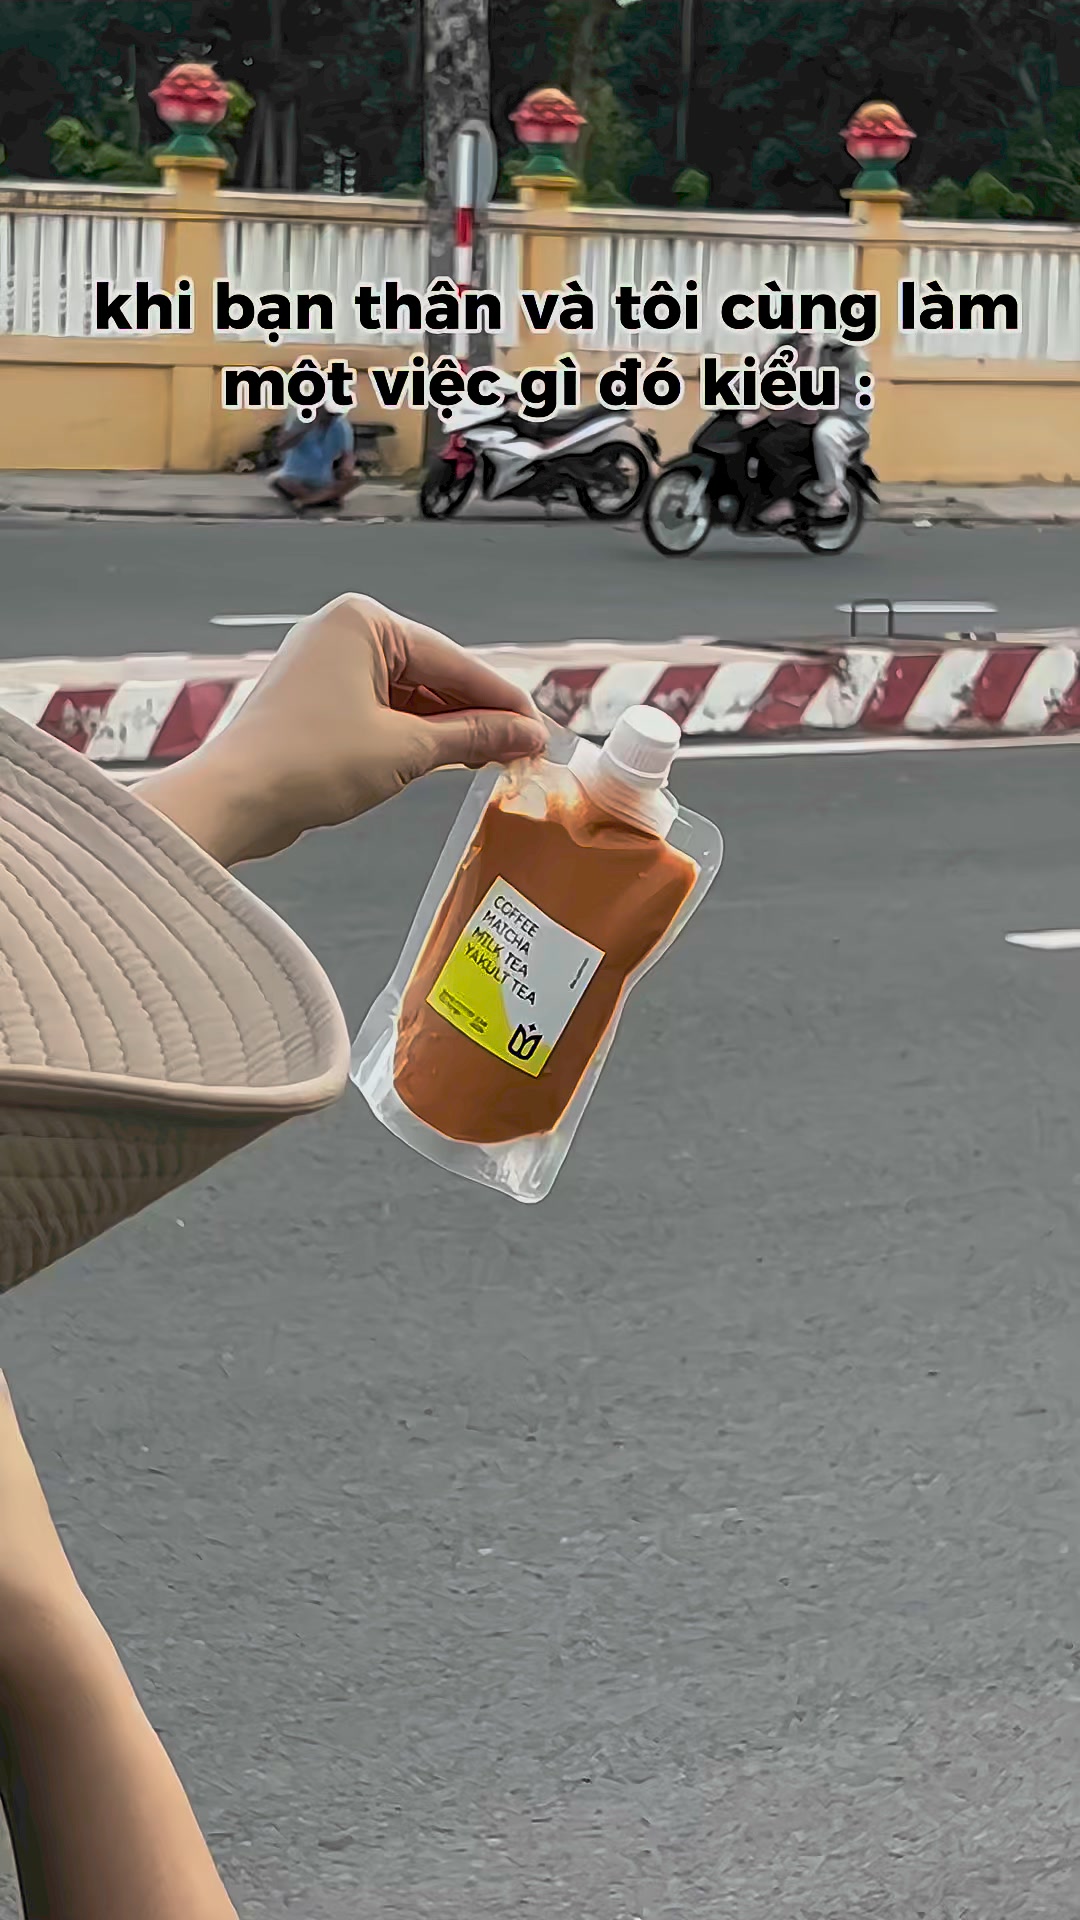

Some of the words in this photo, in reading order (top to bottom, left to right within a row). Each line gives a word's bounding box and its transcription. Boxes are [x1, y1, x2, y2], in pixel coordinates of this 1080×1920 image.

[482, 909, 531, 956] MATCHA
[493, 895, 540, 938] COFFEE
[465, 942, 511, 985] YAKULT
[511, 978, 536, 1006] TEA
[471, 926, 504, 958] MILK
[504, 951, 528, 978] TEA
